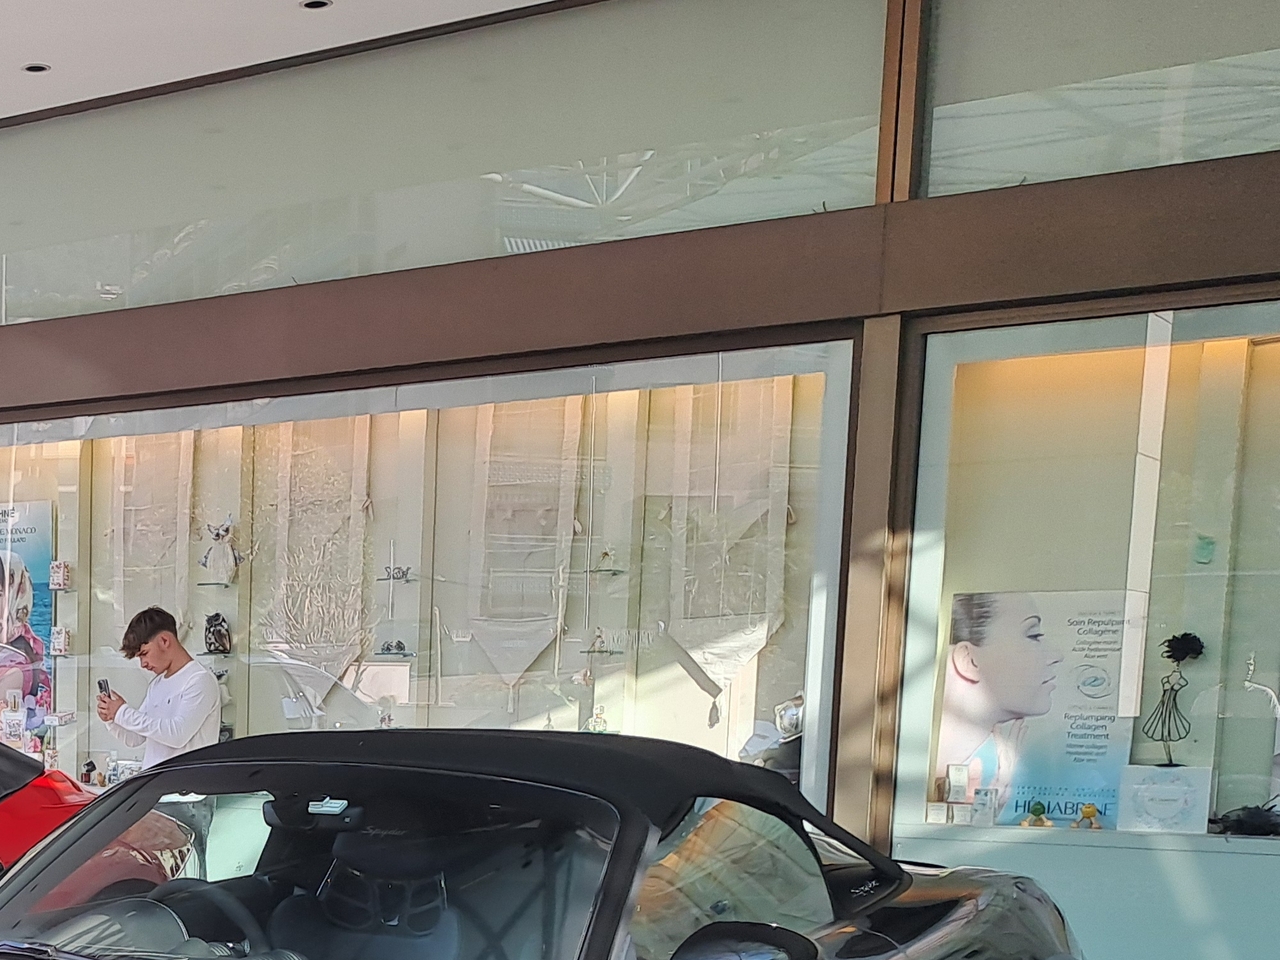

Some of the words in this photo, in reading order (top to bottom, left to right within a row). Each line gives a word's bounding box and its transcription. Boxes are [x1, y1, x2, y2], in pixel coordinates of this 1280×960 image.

[1067, 618, 1086, 627] Soin
[1063, 712, 1116, 724] Replumping
[1069, 722, 1108, 732] Collagen
[1066, 731, 1110, 740] Treatment
